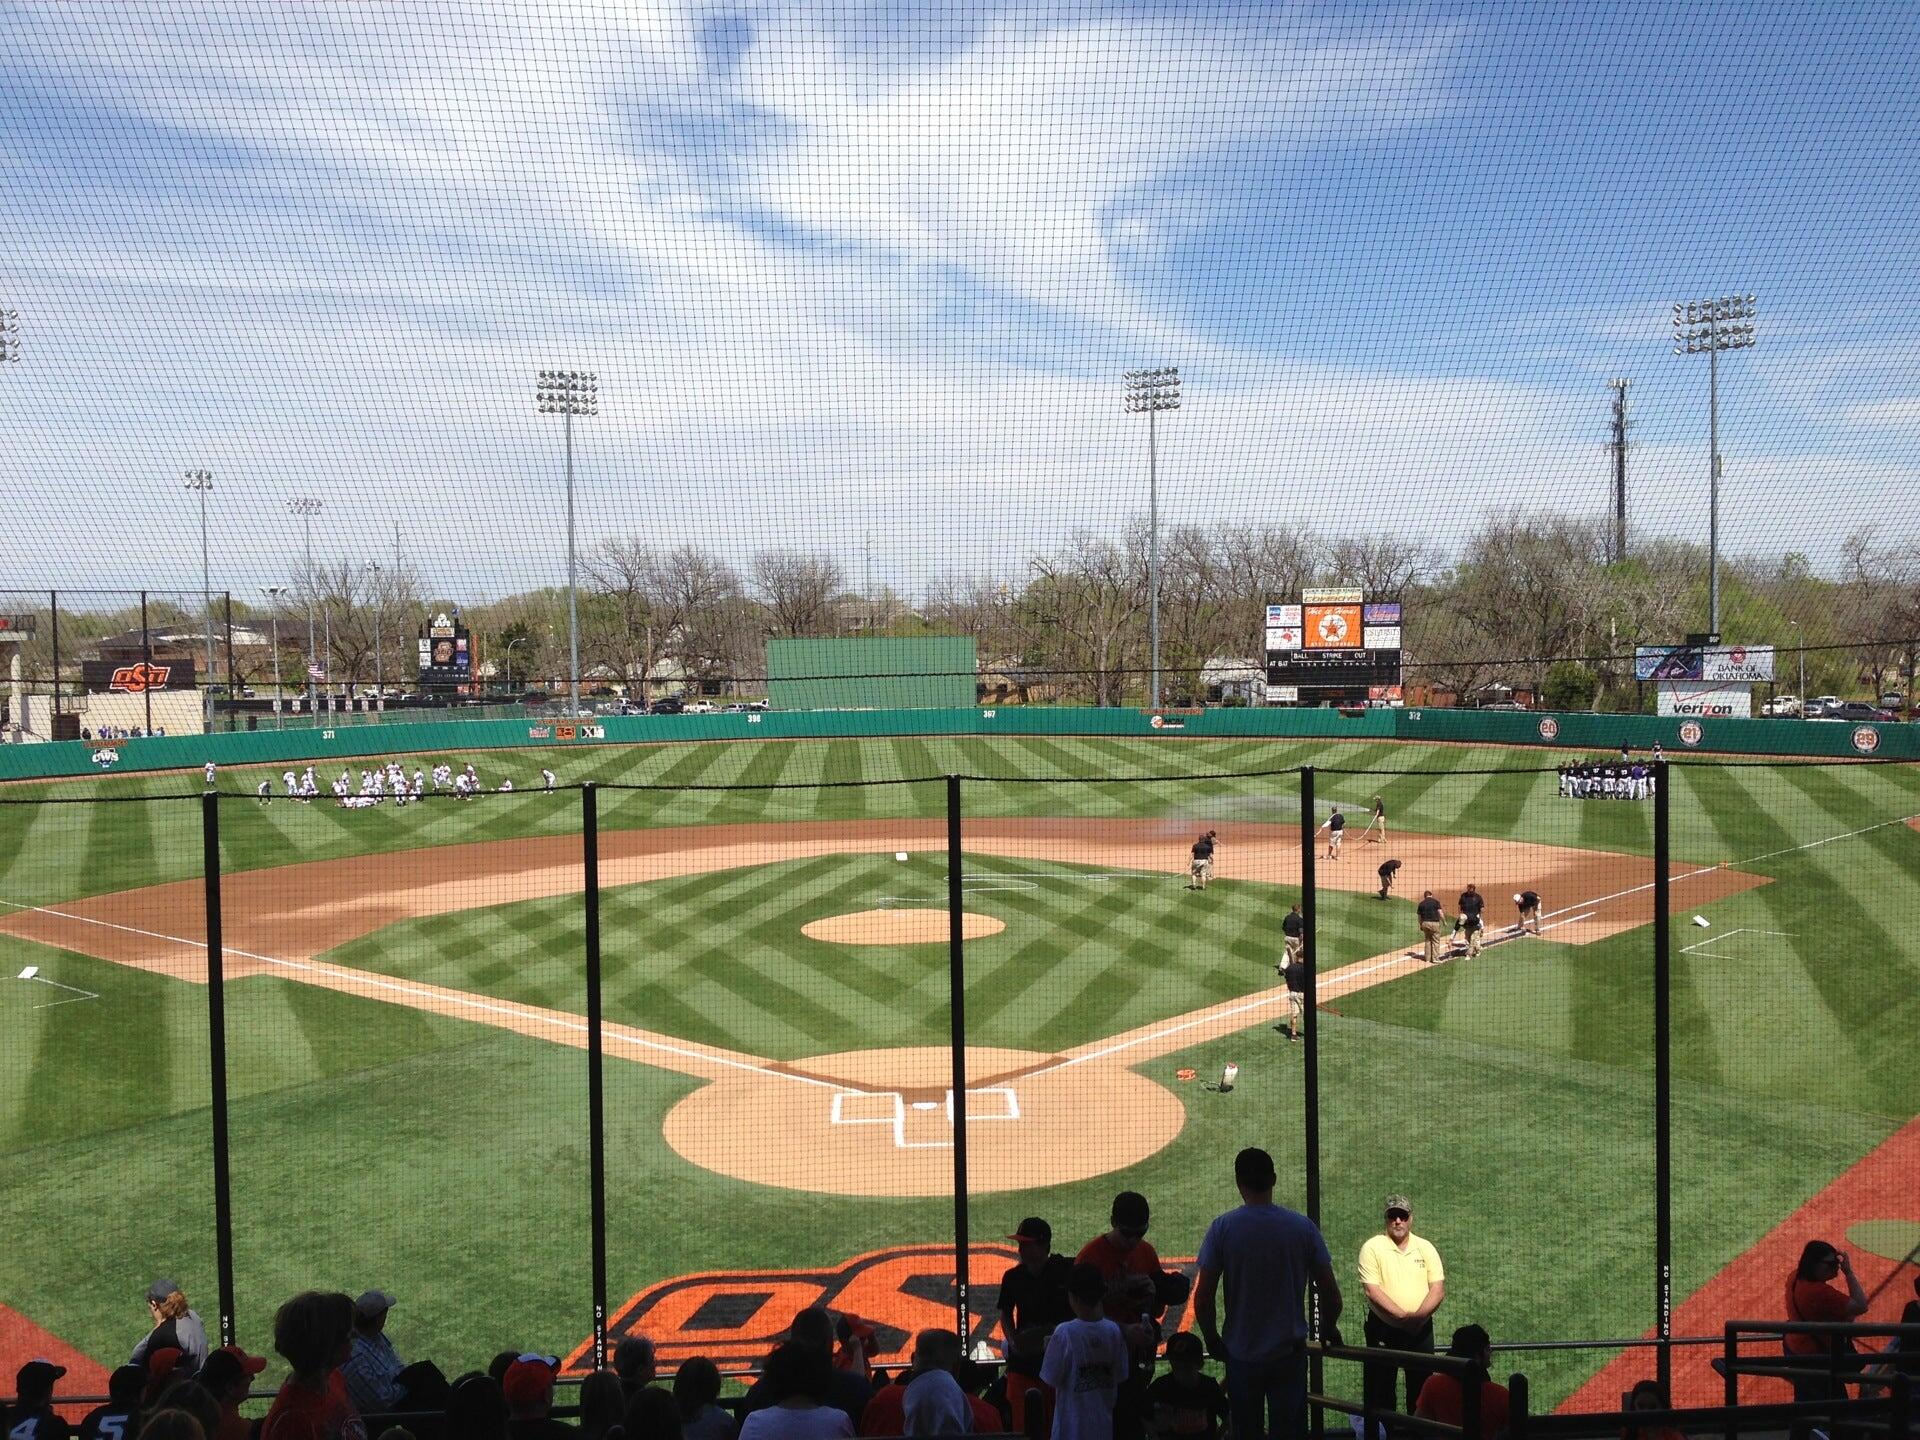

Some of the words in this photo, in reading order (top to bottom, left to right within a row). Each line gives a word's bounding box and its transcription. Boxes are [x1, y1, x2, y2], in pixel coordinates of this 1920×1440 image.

[1717, 664, 1744, 672] BANK
[1745, 664, 1758, 672] OF
[110, 663, 170, 694] OSU
[1712, 672, 1763, 680] OKLAHOMA
[983, 710, 996, 719] 397
[1674, 702, 1733, 716] verizon
[323, 730, 335, 739] 371
[1541, 722, 1556, 734] 20
[1683, 728, 1697, 739] 21
[1856, 732, 1875, 746] 29
[1664, 1265, 1669, 1278] NO
[960, 1284, 966, 1297] NO
[596, 1305, 602, 1318] NO
[222, 1315, 229, 1329] NO
[9, 1417, 39, 1440] 4
[95, 1415, 129, 1440] 5
